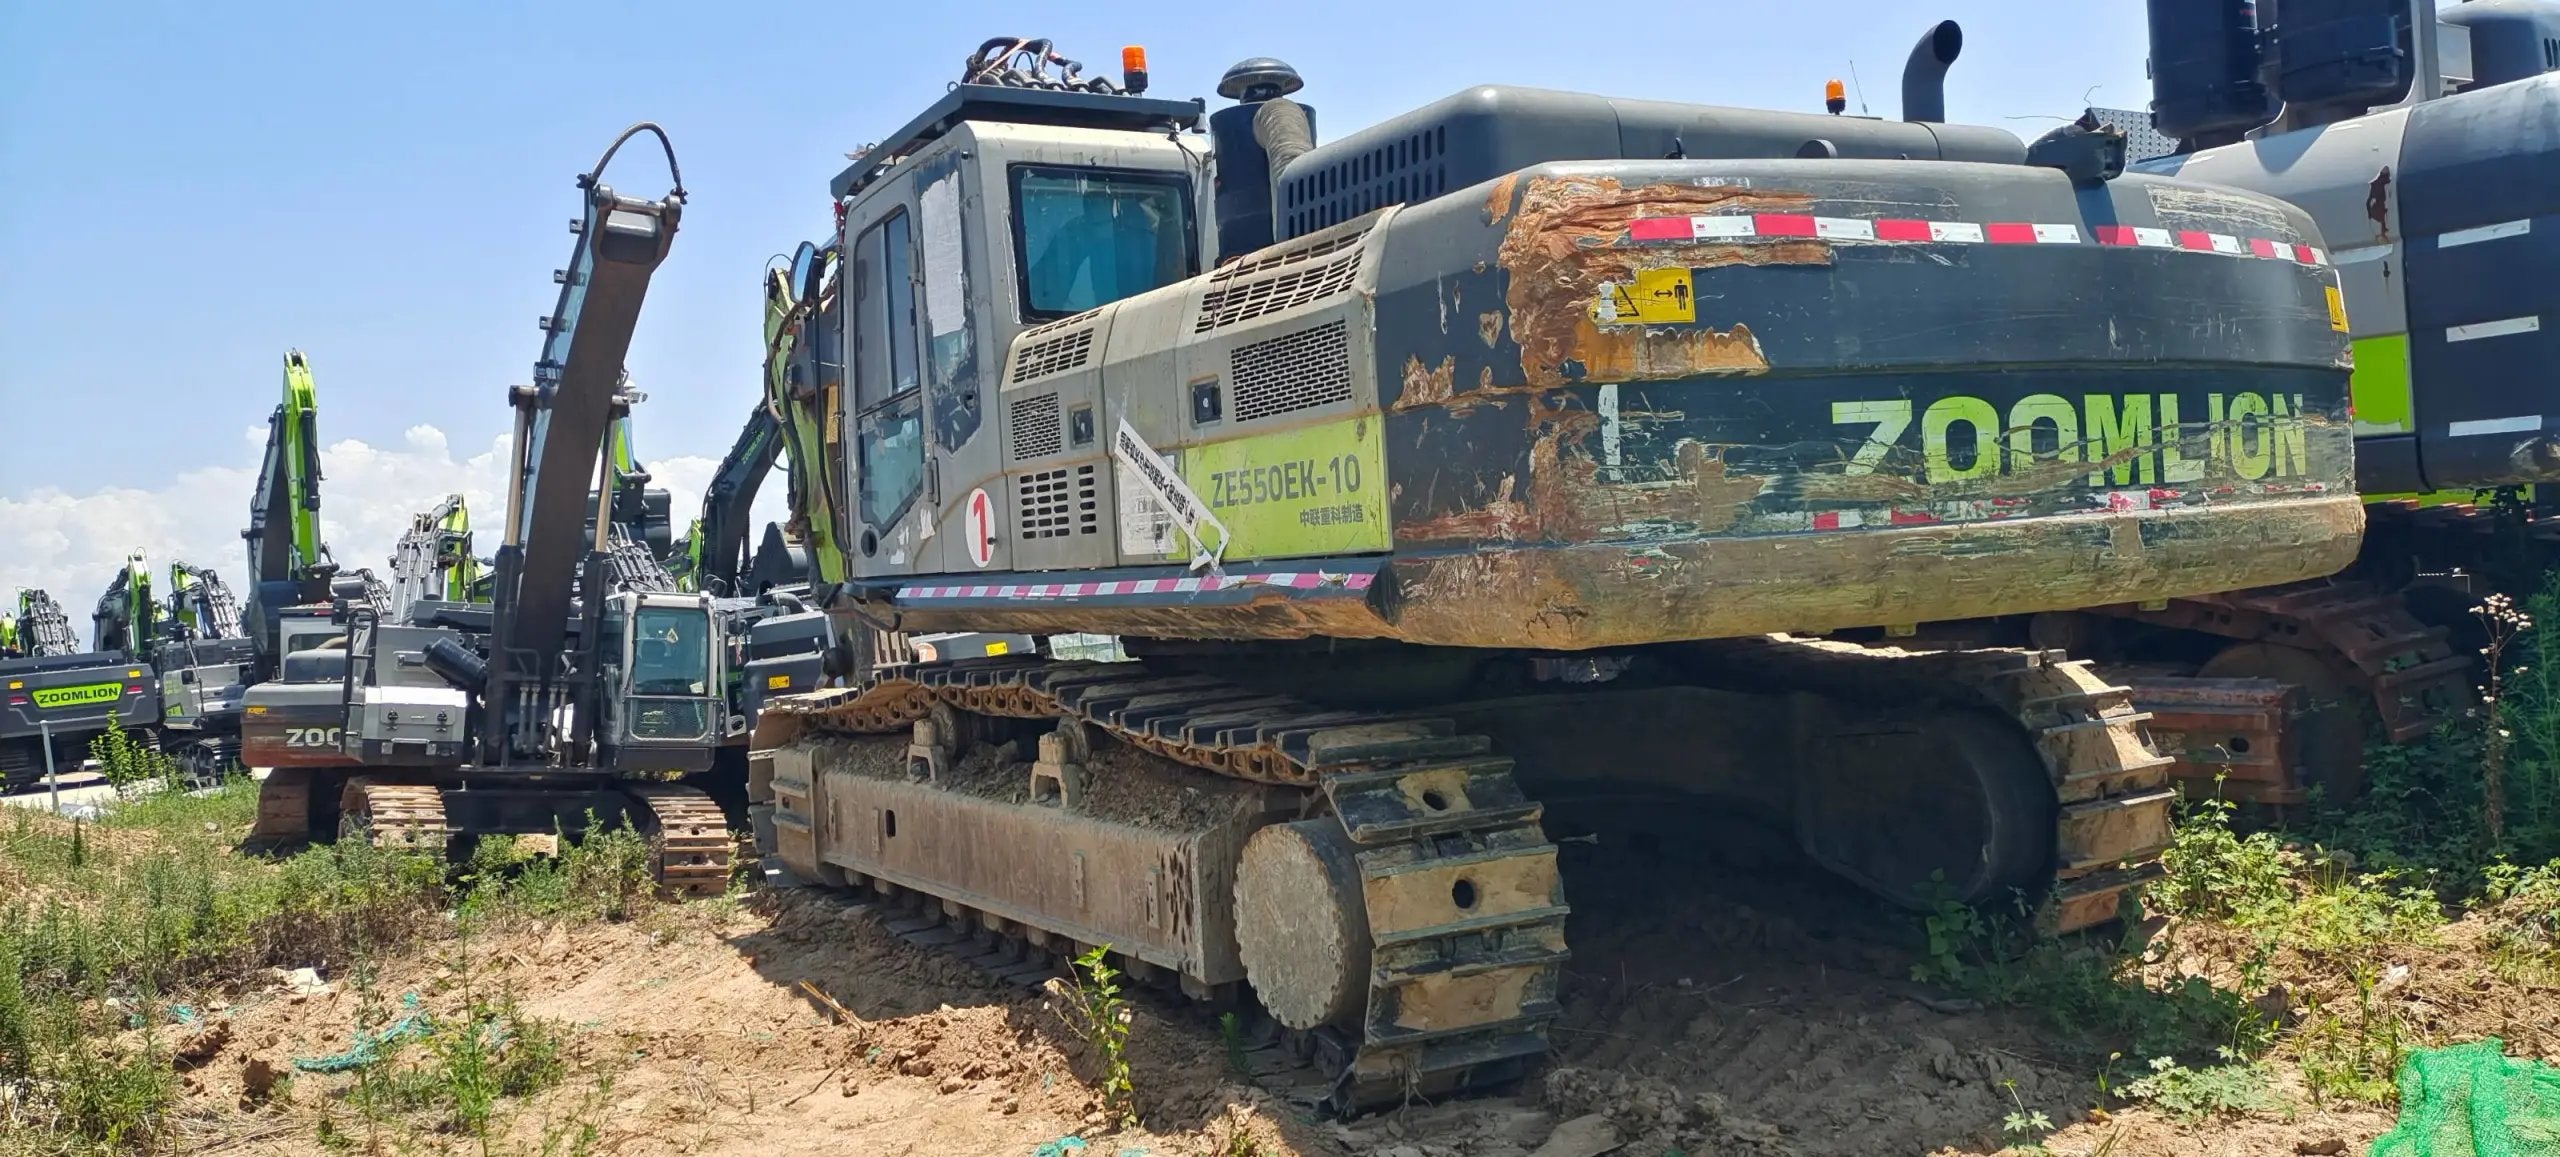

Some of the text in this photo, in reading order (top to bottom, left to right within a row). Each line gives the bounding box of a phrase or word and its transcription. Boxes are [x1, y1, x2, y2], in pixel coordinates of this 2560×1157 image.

[1832, 392, 2305, 488] ZOOMLION
[1211, 454, 1361, 508] ZE550EK-10
[973, 493, 988, 562] 1
[1300, 504, 1364, 527] 中联重科制造
[39, 687, 118, 704] ZOOMLION
